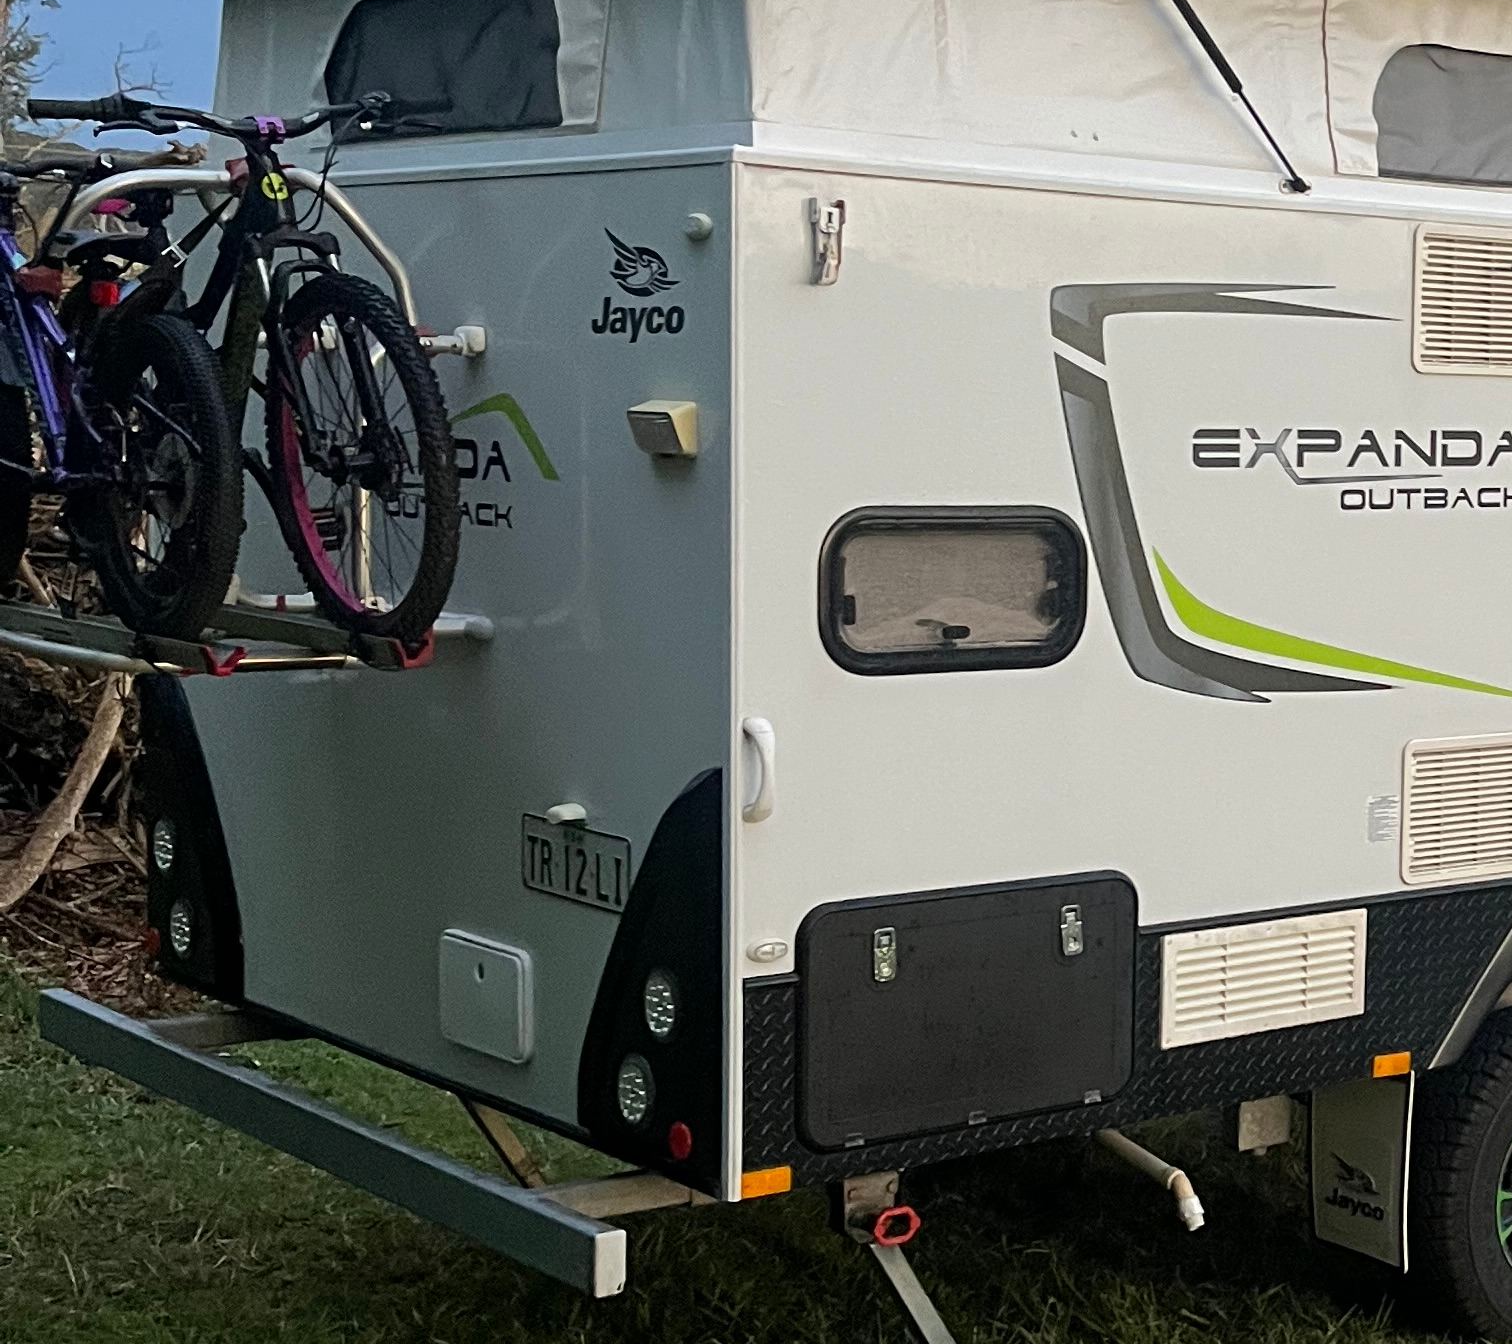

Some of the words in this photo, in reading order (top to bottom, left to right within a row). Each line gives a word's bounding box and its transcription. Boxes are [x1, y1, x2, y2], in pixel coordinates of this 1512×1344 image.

[591, 296, 686, 344] Jayco
[386, 494, 513, 529] OUACK
[1325, 1187, 1385, 1221] Jayco
